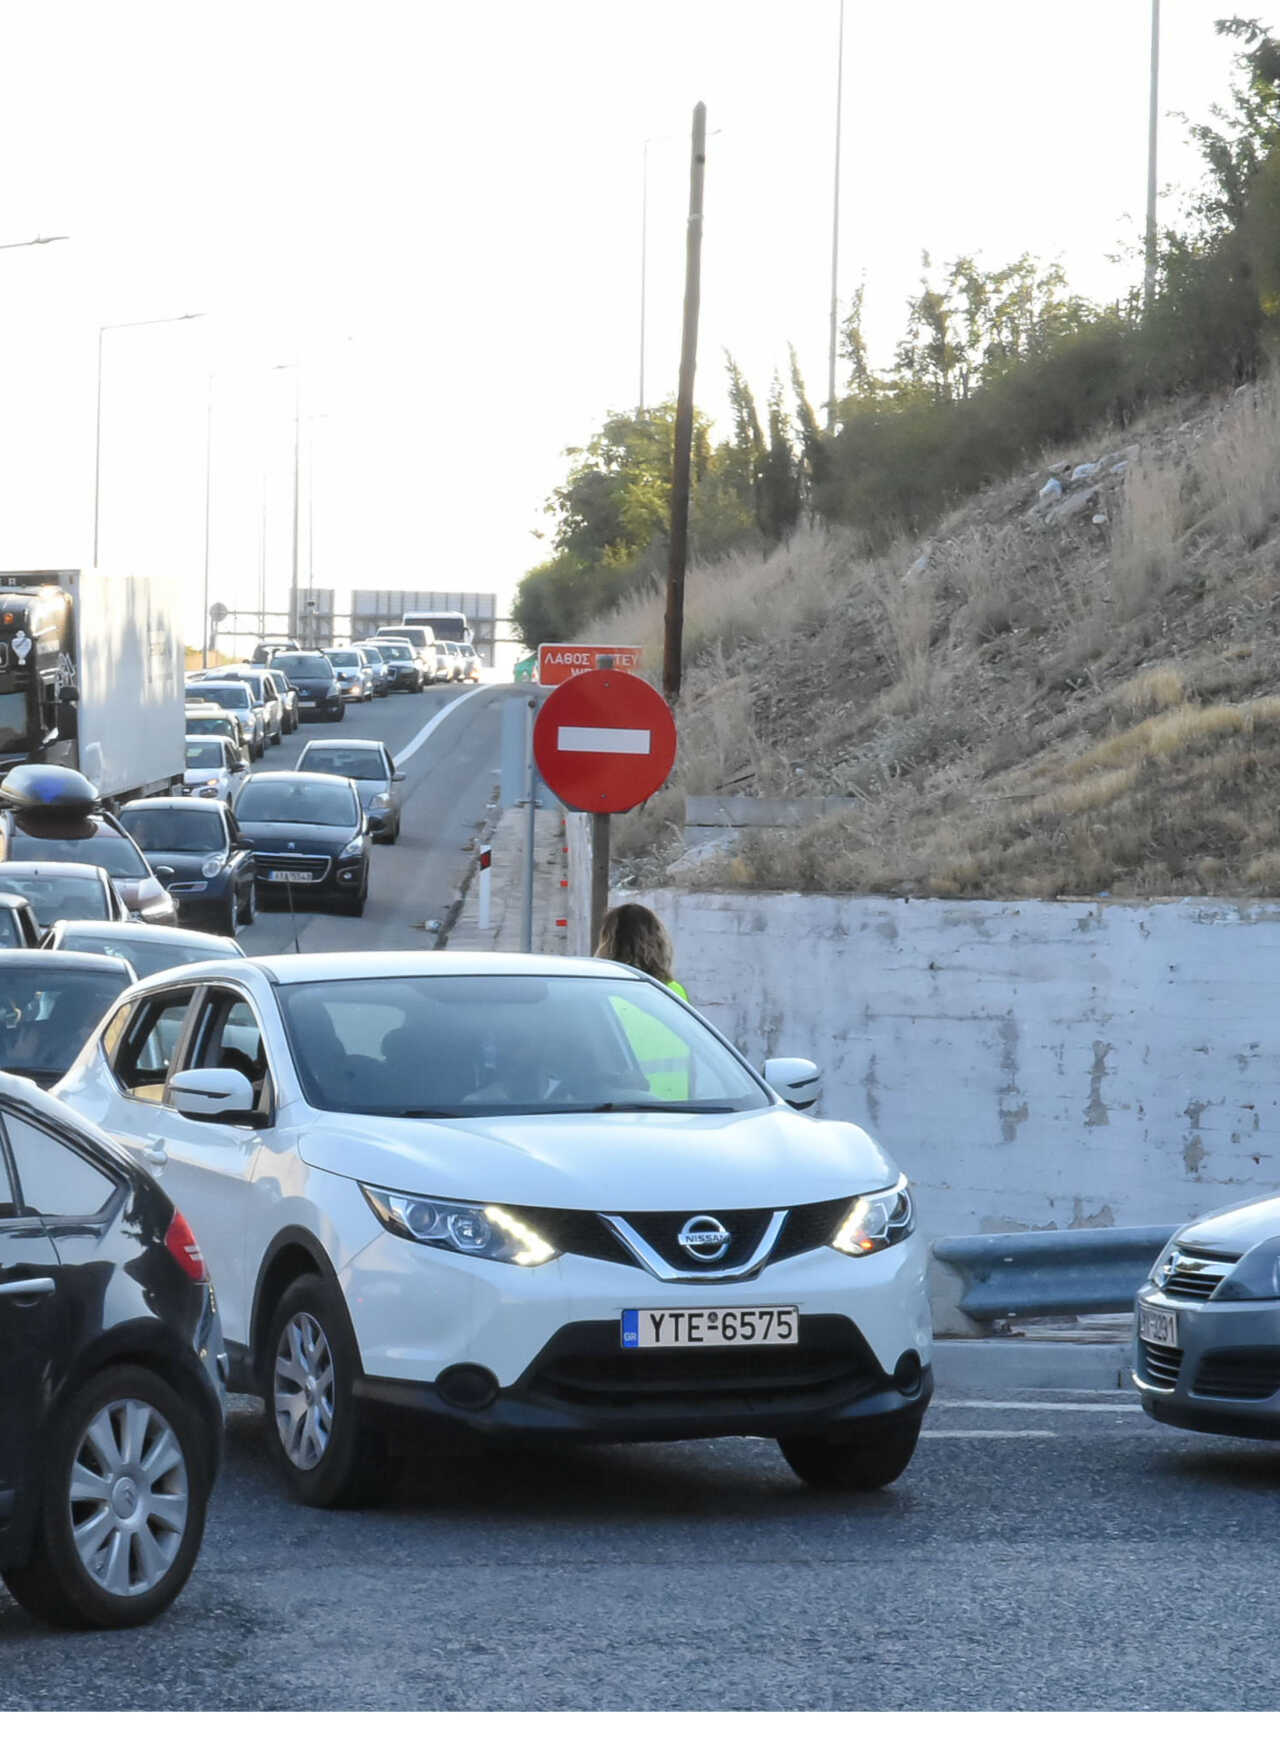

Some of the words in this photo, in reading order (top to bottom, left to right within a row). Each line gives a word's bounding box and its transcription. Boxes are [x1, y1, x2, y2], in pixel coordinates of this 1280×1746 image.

[544, 653, 591, 665] ΛΑΘΟΣ
[685, 1234, 730, 1245] NISSAN
[624, 1331, 637, 1341] GR
